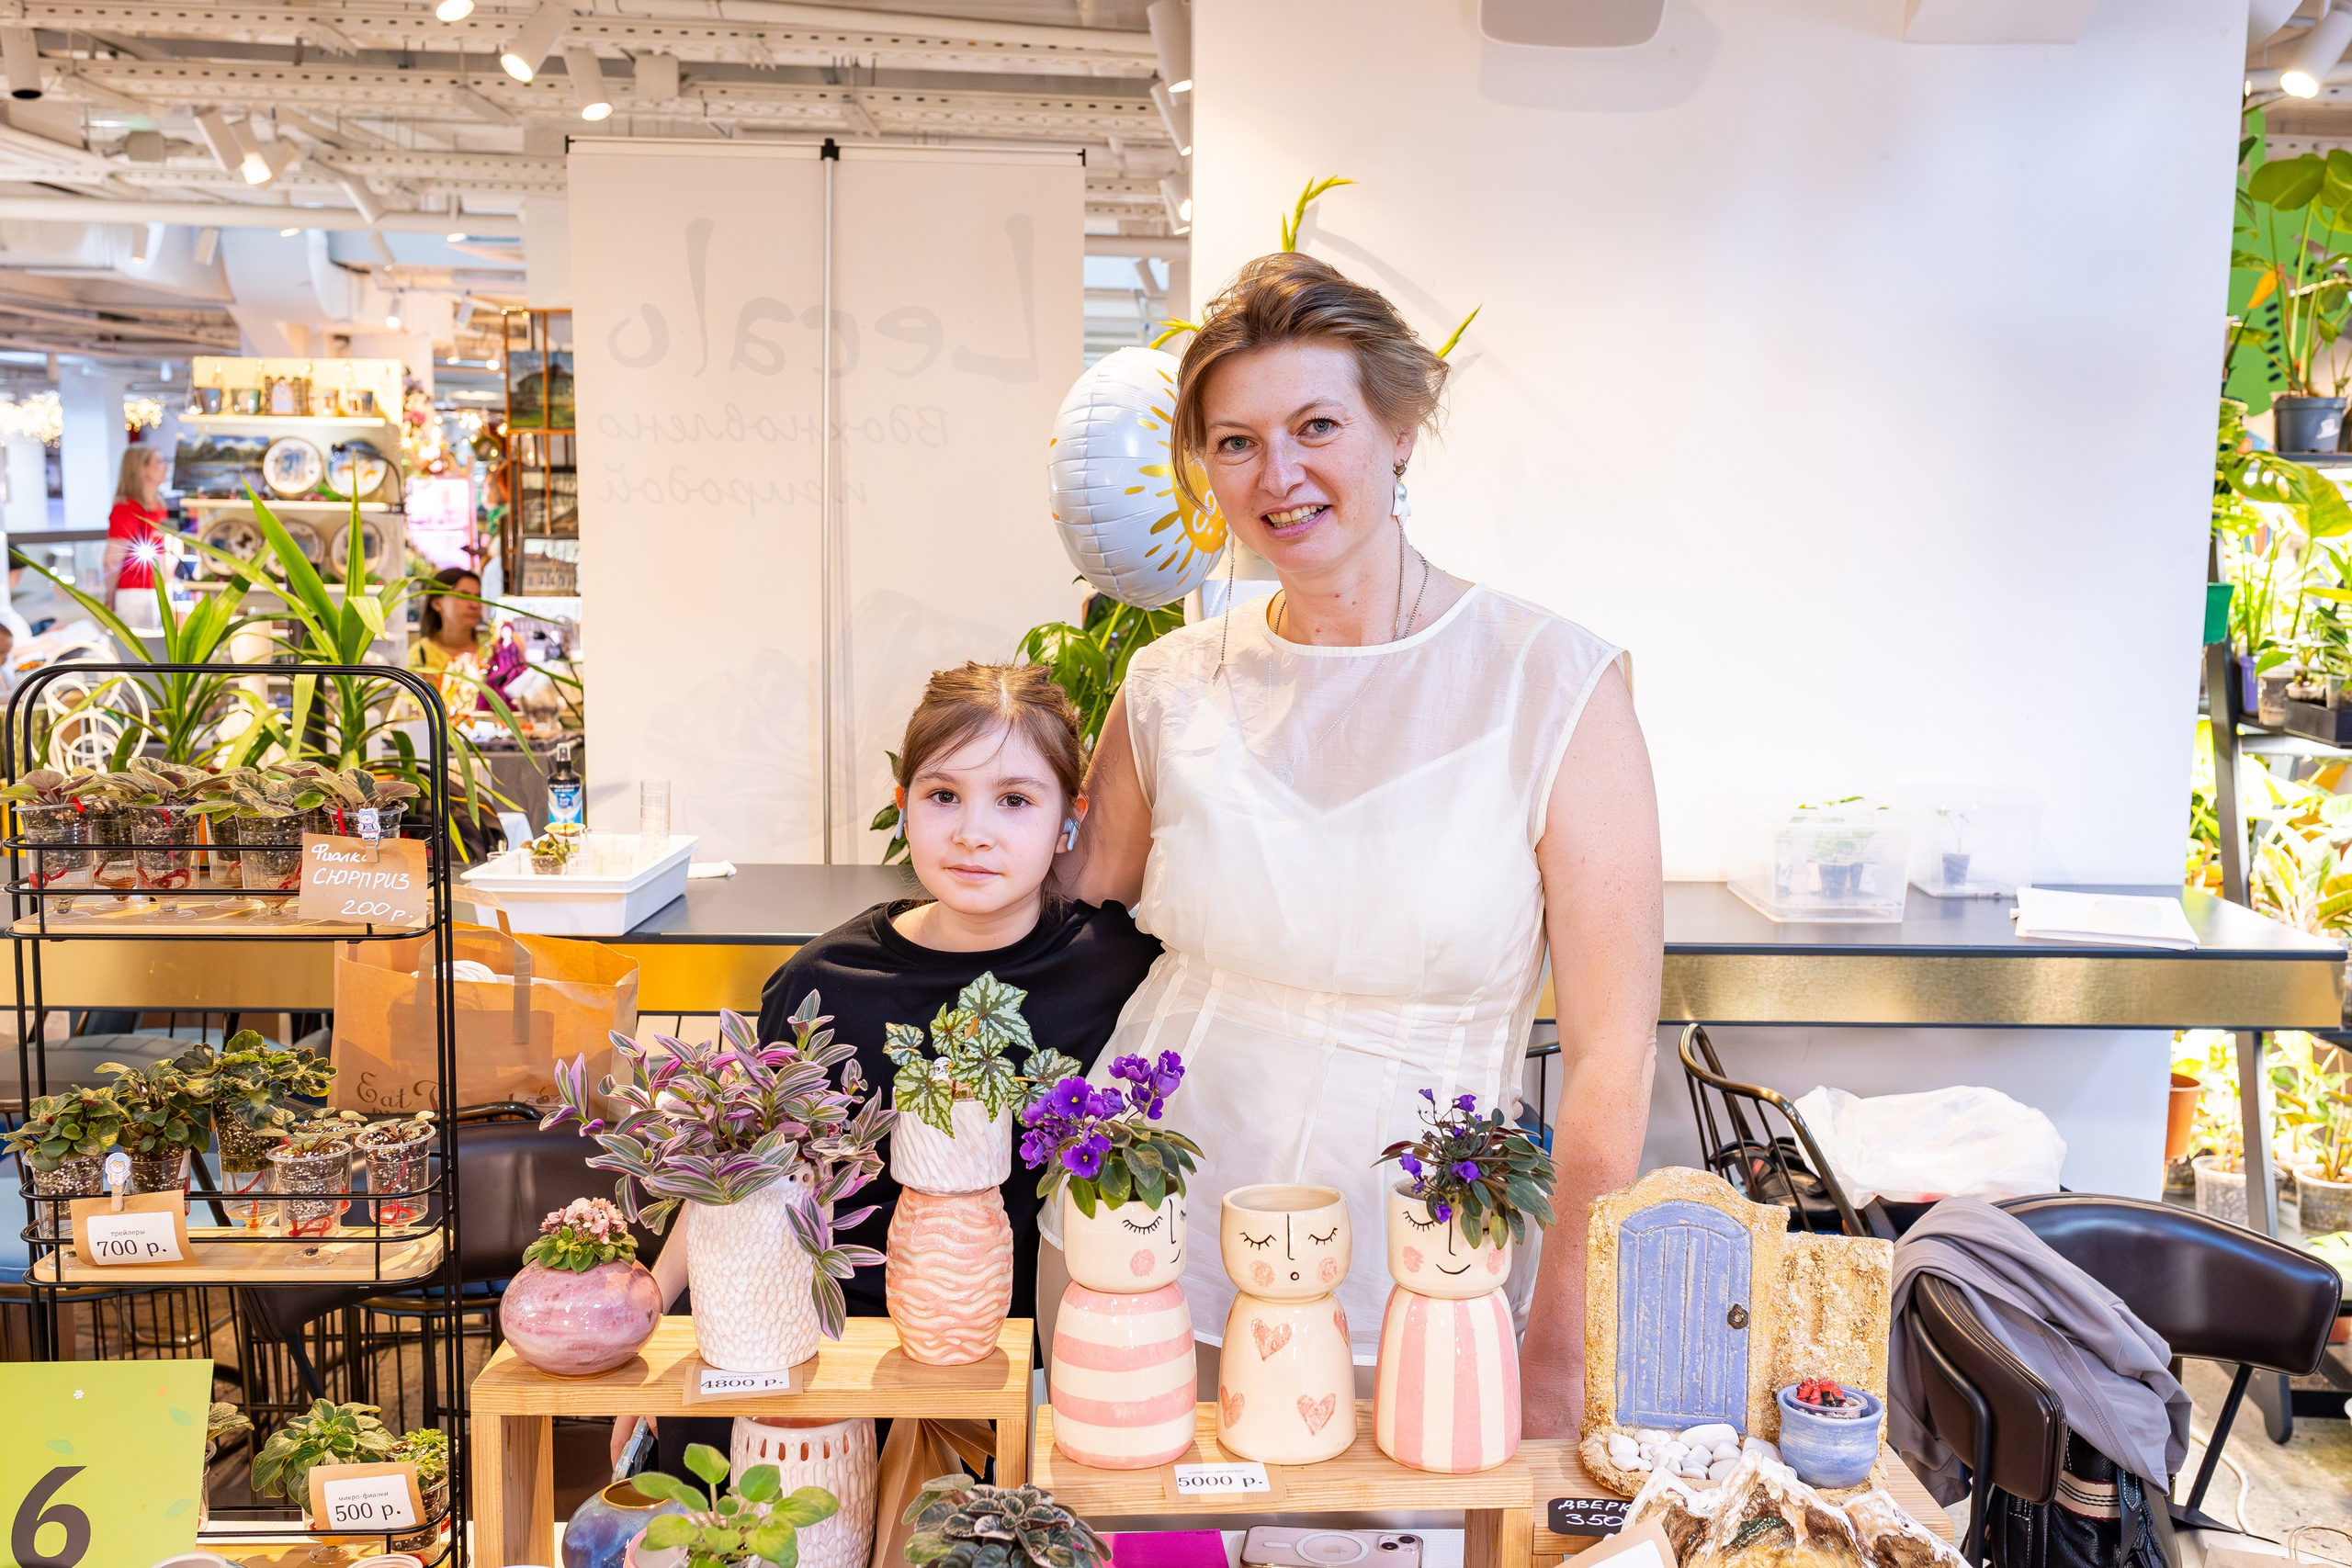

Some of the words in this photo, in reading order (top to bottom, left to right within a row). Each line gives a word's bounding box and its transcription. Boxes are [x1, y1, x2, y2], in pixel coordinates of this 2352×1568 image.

[312, 867, 410, 890] СЮРПРИЗ
[341, 899, 390, 916] 200
[356, 1071, 413, 1109] Eat
[110, 1229, 145, 1237] трейлеры
[96, 1239, 138, 1257] 700
[146, 1242, 167, 1257] р.
[701, 1379, 755, 1389] 4800
[1178, 1475, 1233, 1487] 5000
[338, 1492, 389, 1501] микро-фиалки
[11, 1465, 91, 1568] 6
[335, 1502, 373, 1522] 500
[381, 1504, 401, 1520] р.
